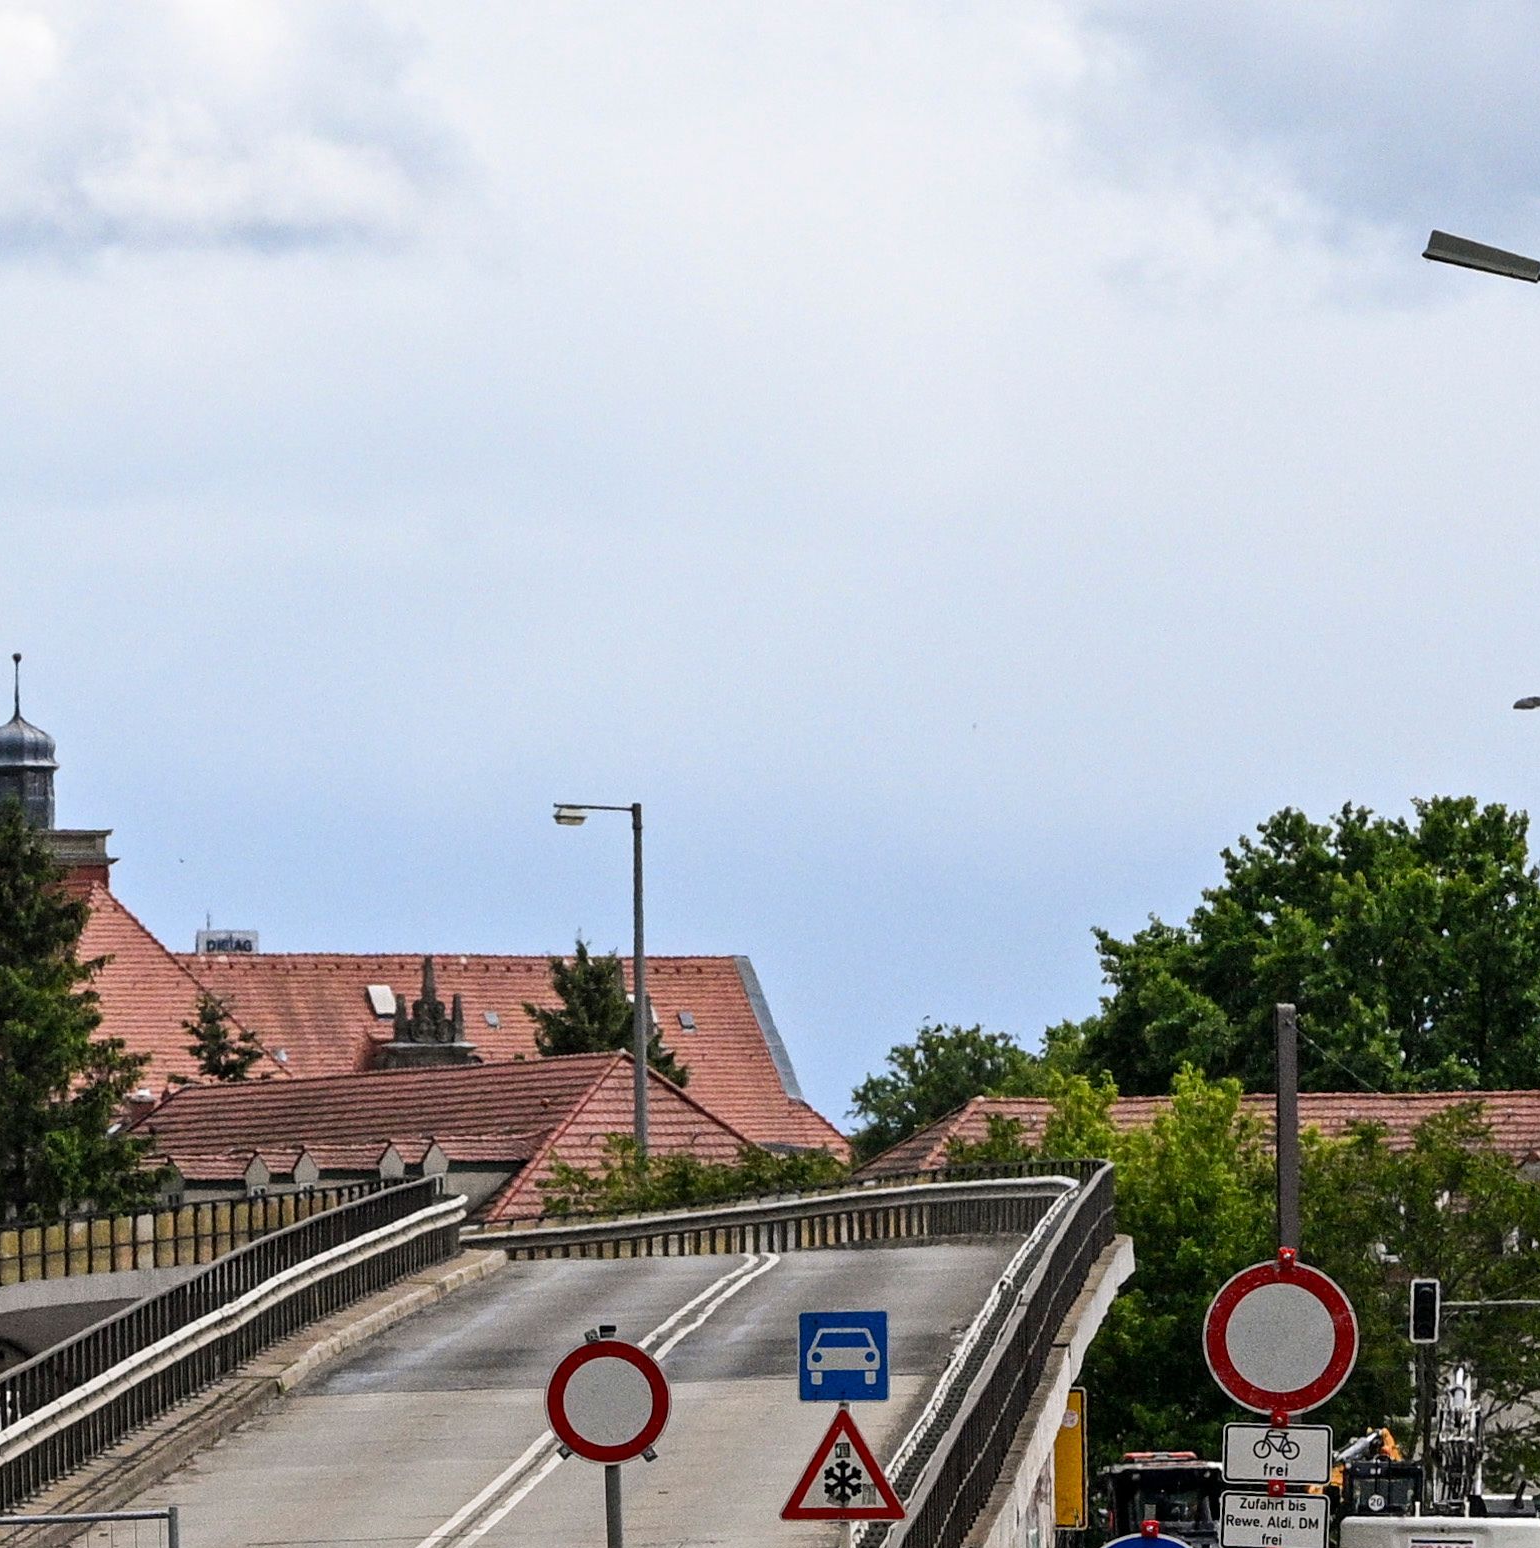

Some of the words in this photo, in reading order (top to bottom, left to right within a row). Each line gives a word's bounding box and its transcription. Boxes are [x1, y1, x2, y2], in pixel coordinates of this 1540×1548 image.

[1263, 1463, 1289, 1477] frei
[1239, 1497, 1285, 1511] Zufahrt
[1288, 1498, 1307, 1512] bis
[1369, 1497, 1384, 1507] 20
[1298, 1518, 1319, 1530] DM
[1261, 1534, 1282, 1546] frei
